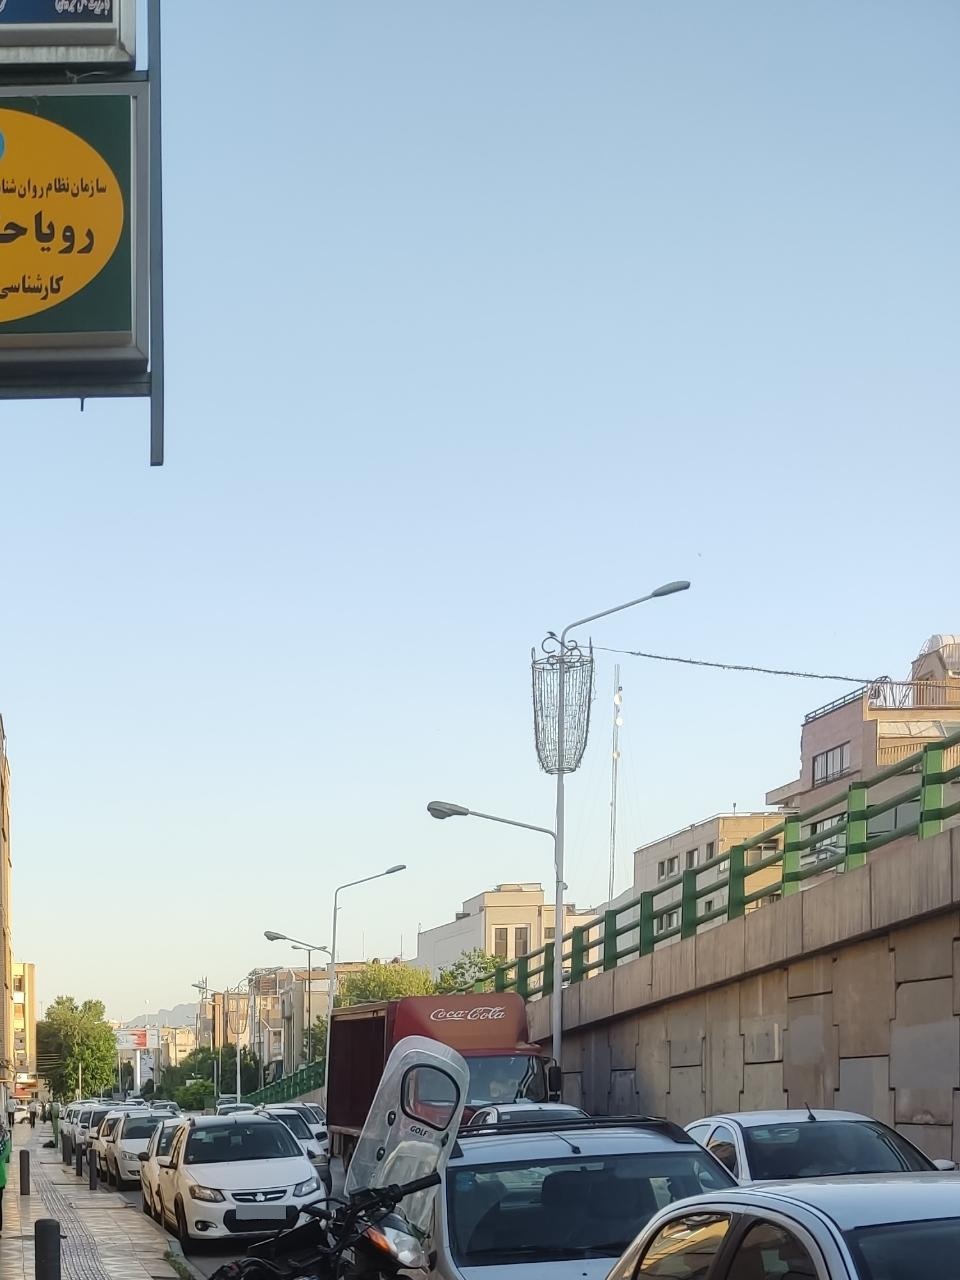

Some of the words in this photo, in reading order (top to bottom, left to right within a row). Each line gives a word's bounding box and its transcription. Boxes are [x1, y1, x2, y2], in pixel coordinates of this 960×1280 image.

[45, 175, 70, 198] نظام
[70, 176, 107, 198] سازمان
[34, 210, 95, 254] رویا
[429, 1006, 506, 1021] Coca-Cola
[410, 1125, 428, 1137] GOLF
